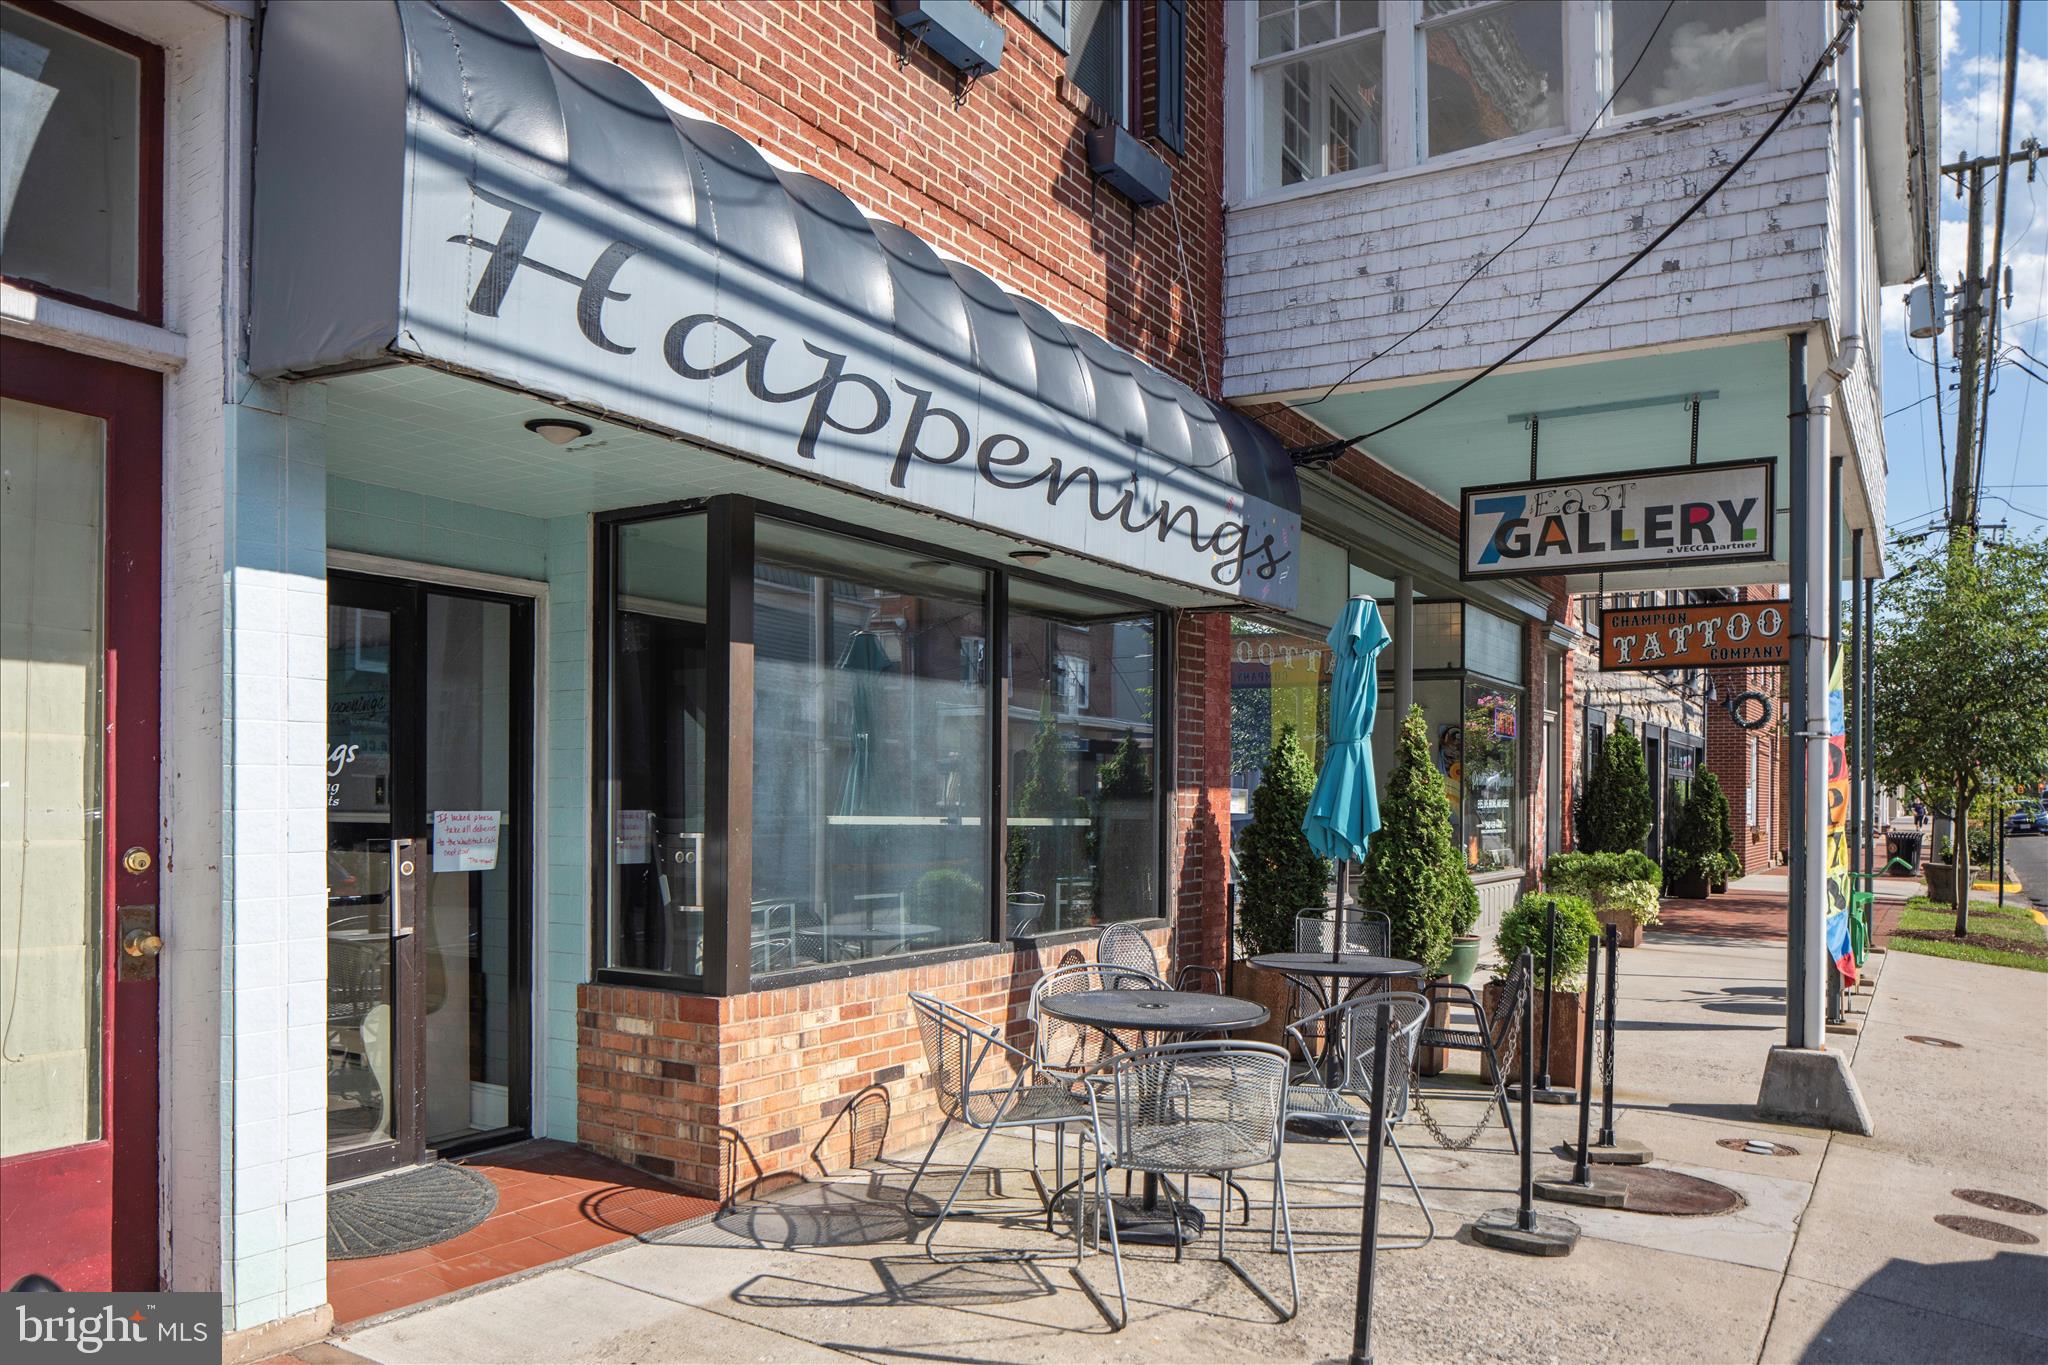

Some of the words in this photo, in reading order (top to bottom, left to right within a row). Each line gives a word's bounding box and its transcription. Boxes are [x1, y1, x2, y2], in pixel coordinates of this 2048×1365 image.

[446, 186, 1291, 586] Happenings
[1474, 494, 1526, 565] 7
[1495, 497, 1759, 559] GALLERY
[1676, 543, 1710, 553] VECCA
[1712, 541, 1757, 553] partner
[1612, 612, 1687, 628] CHAMPION
[1613, 607, 1783, 664] TATTOO
[1710, 646, 1783, 660] COMPANY
[436, 813, 448, 823] If
[473, 814, 493, 823] please
